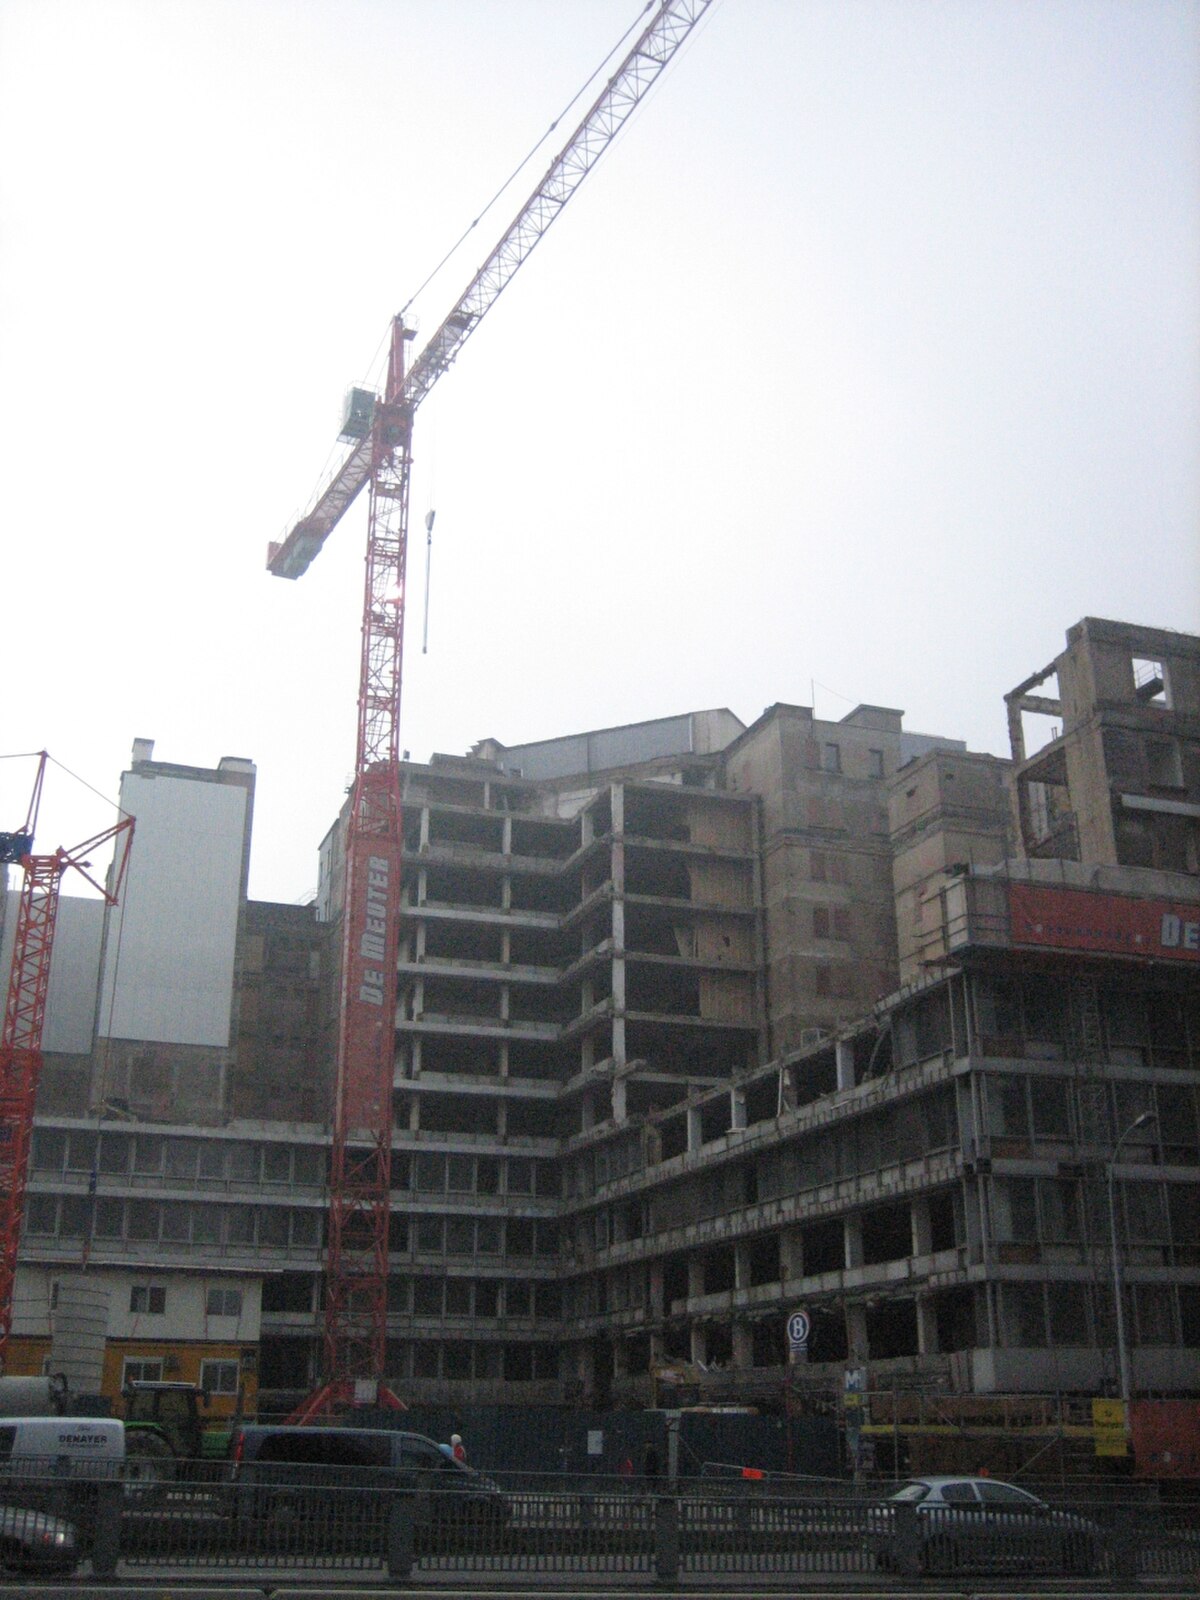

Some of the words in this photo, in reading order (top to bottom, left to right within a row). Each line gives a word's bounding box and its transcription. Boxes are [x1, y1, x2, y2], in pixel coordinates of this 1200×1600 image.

[361, 856, 388, 962] MEUTER
[1161, 913, 1200, 949] DE
[359, 970, 384, 1006] DE
